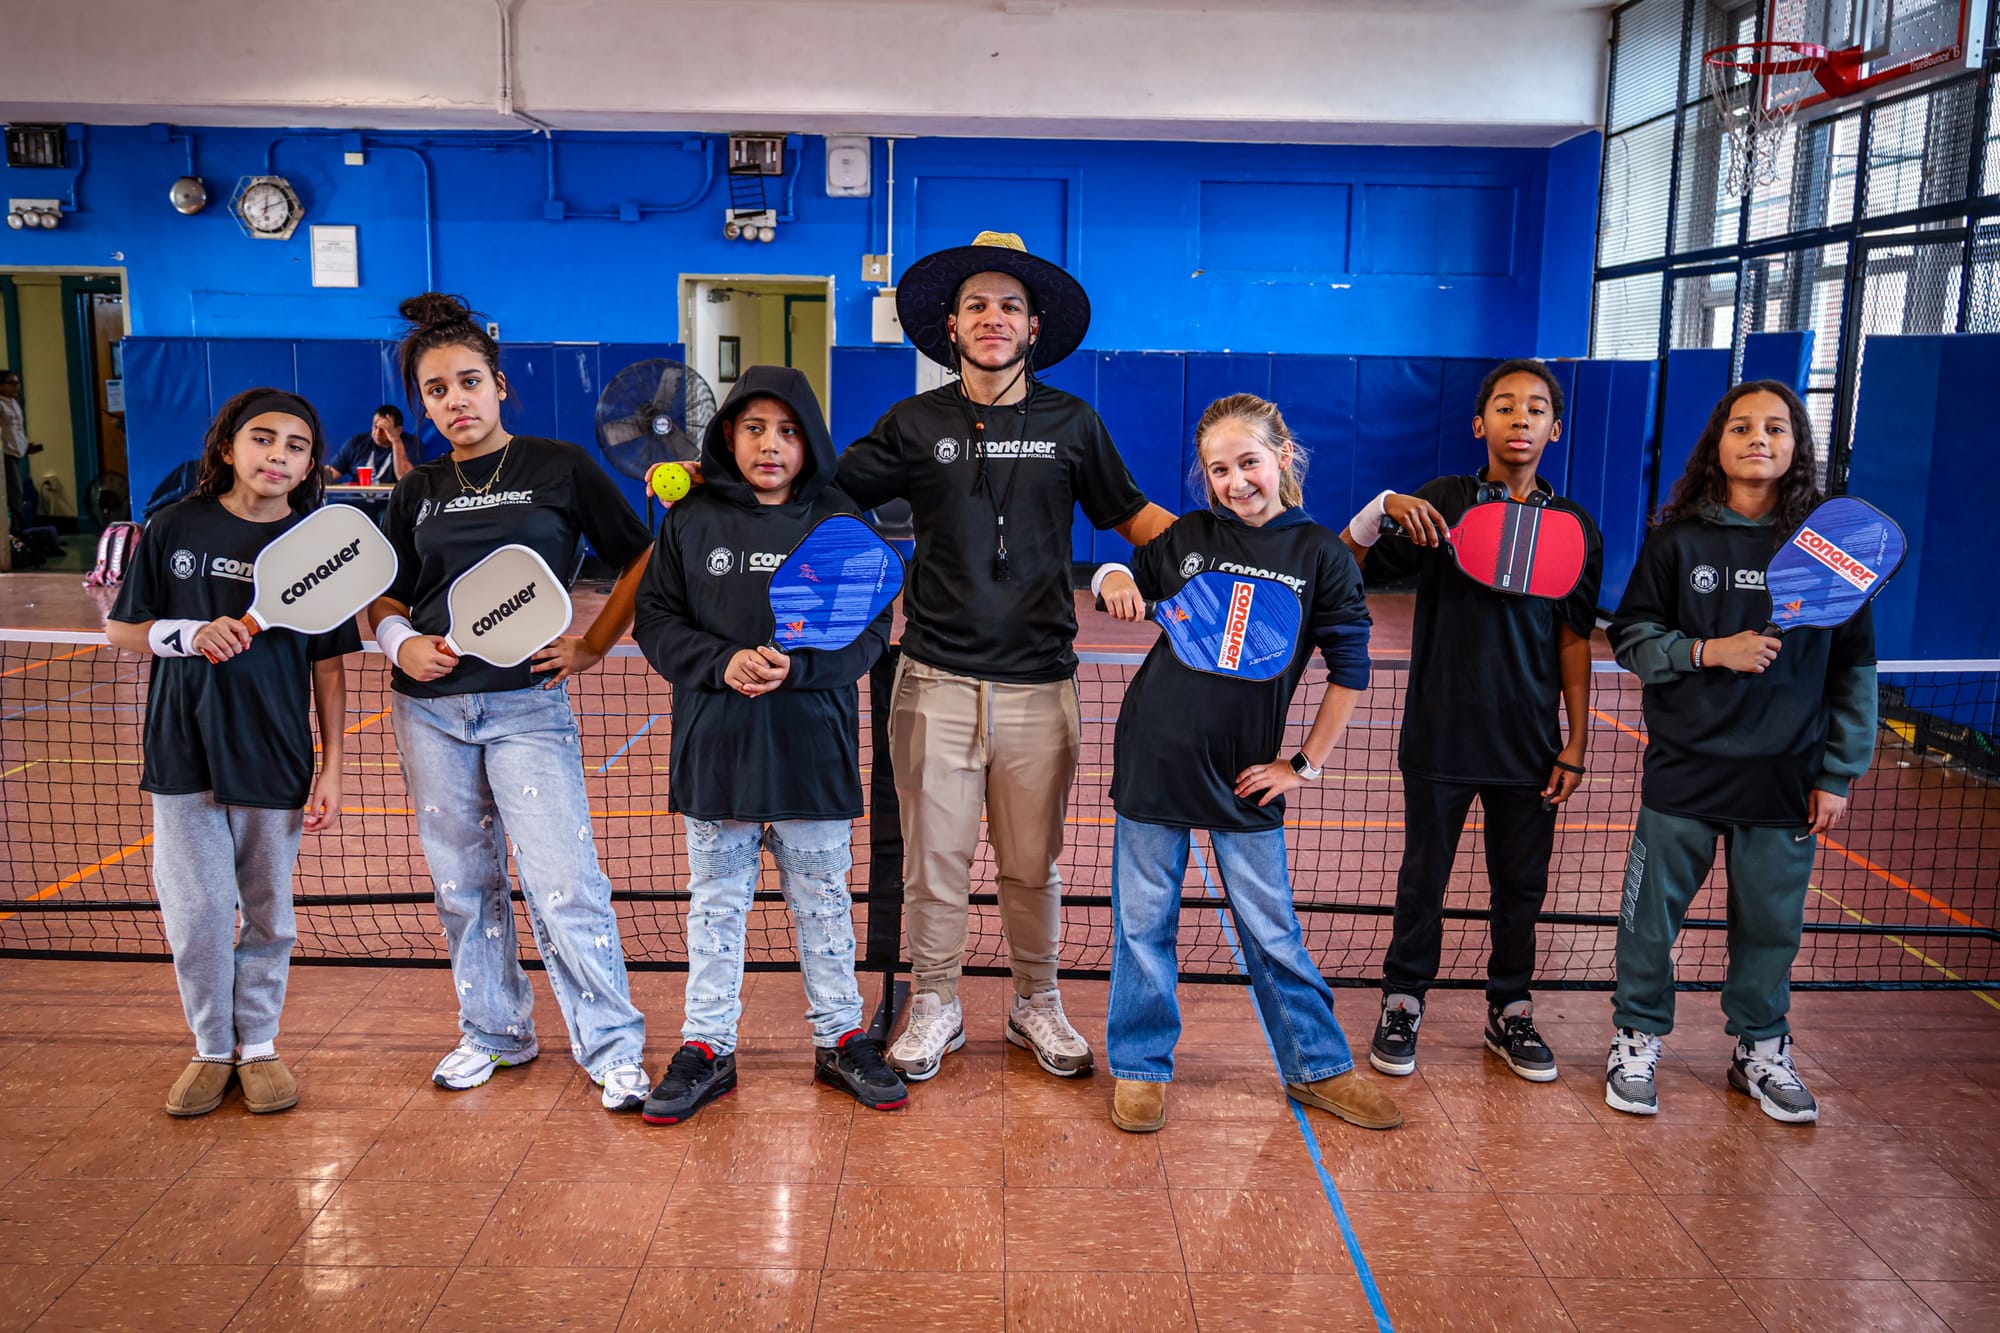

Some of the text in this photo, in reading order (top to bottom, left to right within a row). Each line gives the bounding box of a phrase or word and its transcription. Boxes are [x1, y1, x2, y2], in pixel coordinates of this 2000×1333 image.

[1876, 528, 1889, 567] JOURNEY
[876, 554, 889, 594] JOURNEY
[1248, 650, 1286, 666] JOURNEY
